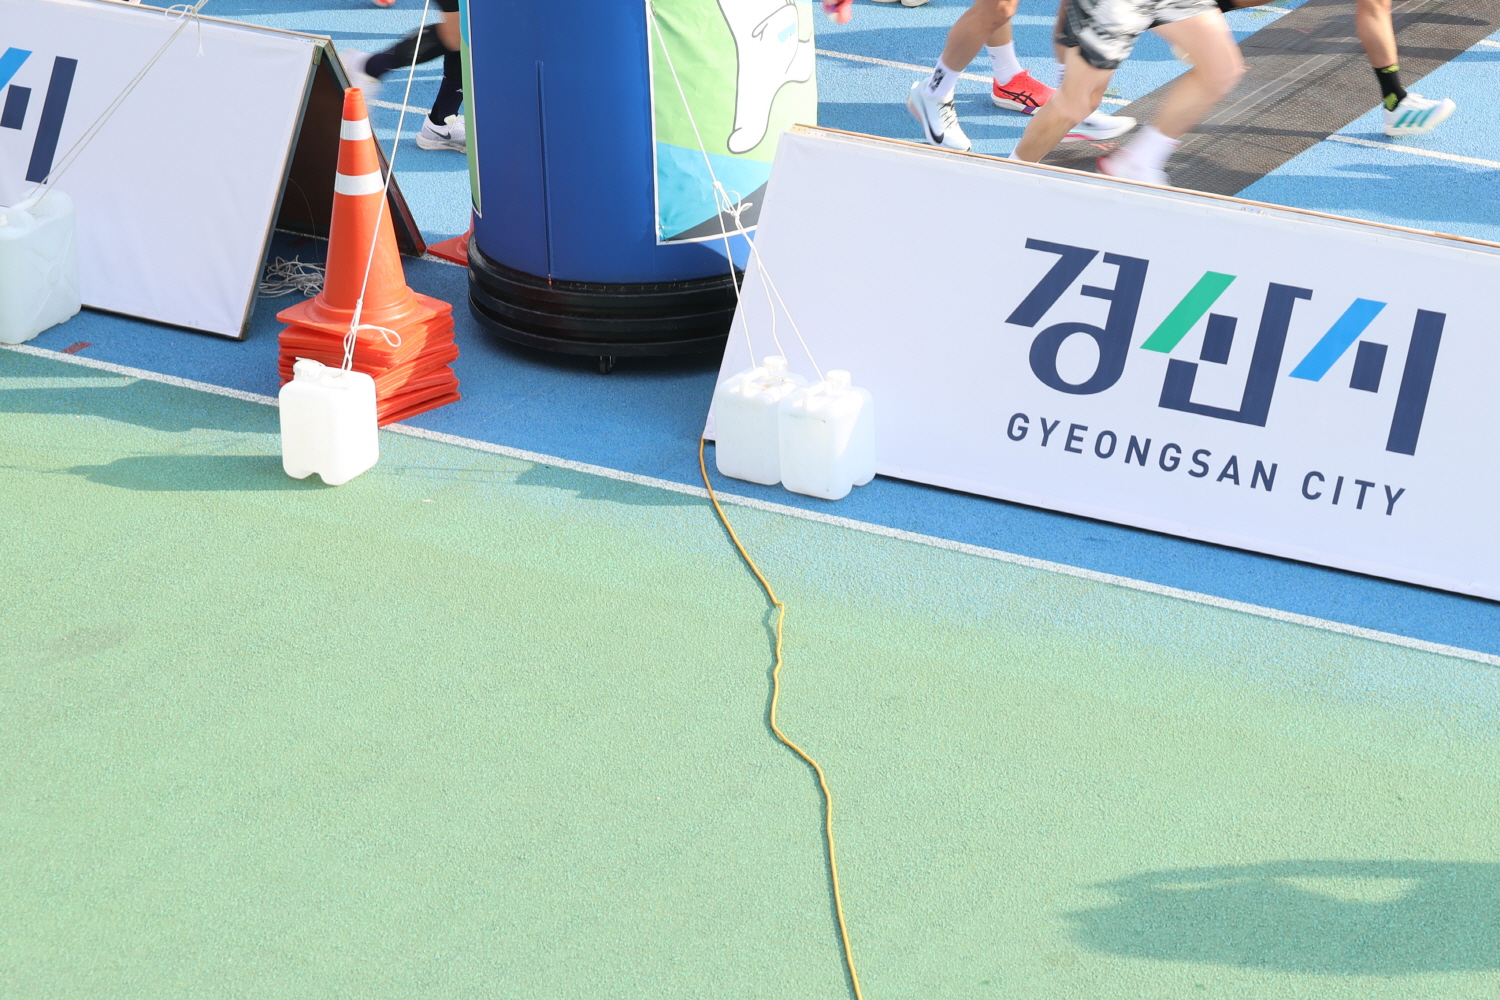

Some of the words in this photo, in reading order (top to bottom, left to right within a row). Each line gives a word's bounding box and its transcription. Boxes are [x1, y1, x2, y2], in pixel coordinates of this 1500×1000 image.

[1004, 237, 1447, 457] 경산시
[1006, 411, 1278, 493] GYEONGSAN
[1301, 470, 1406, 517] CITY
